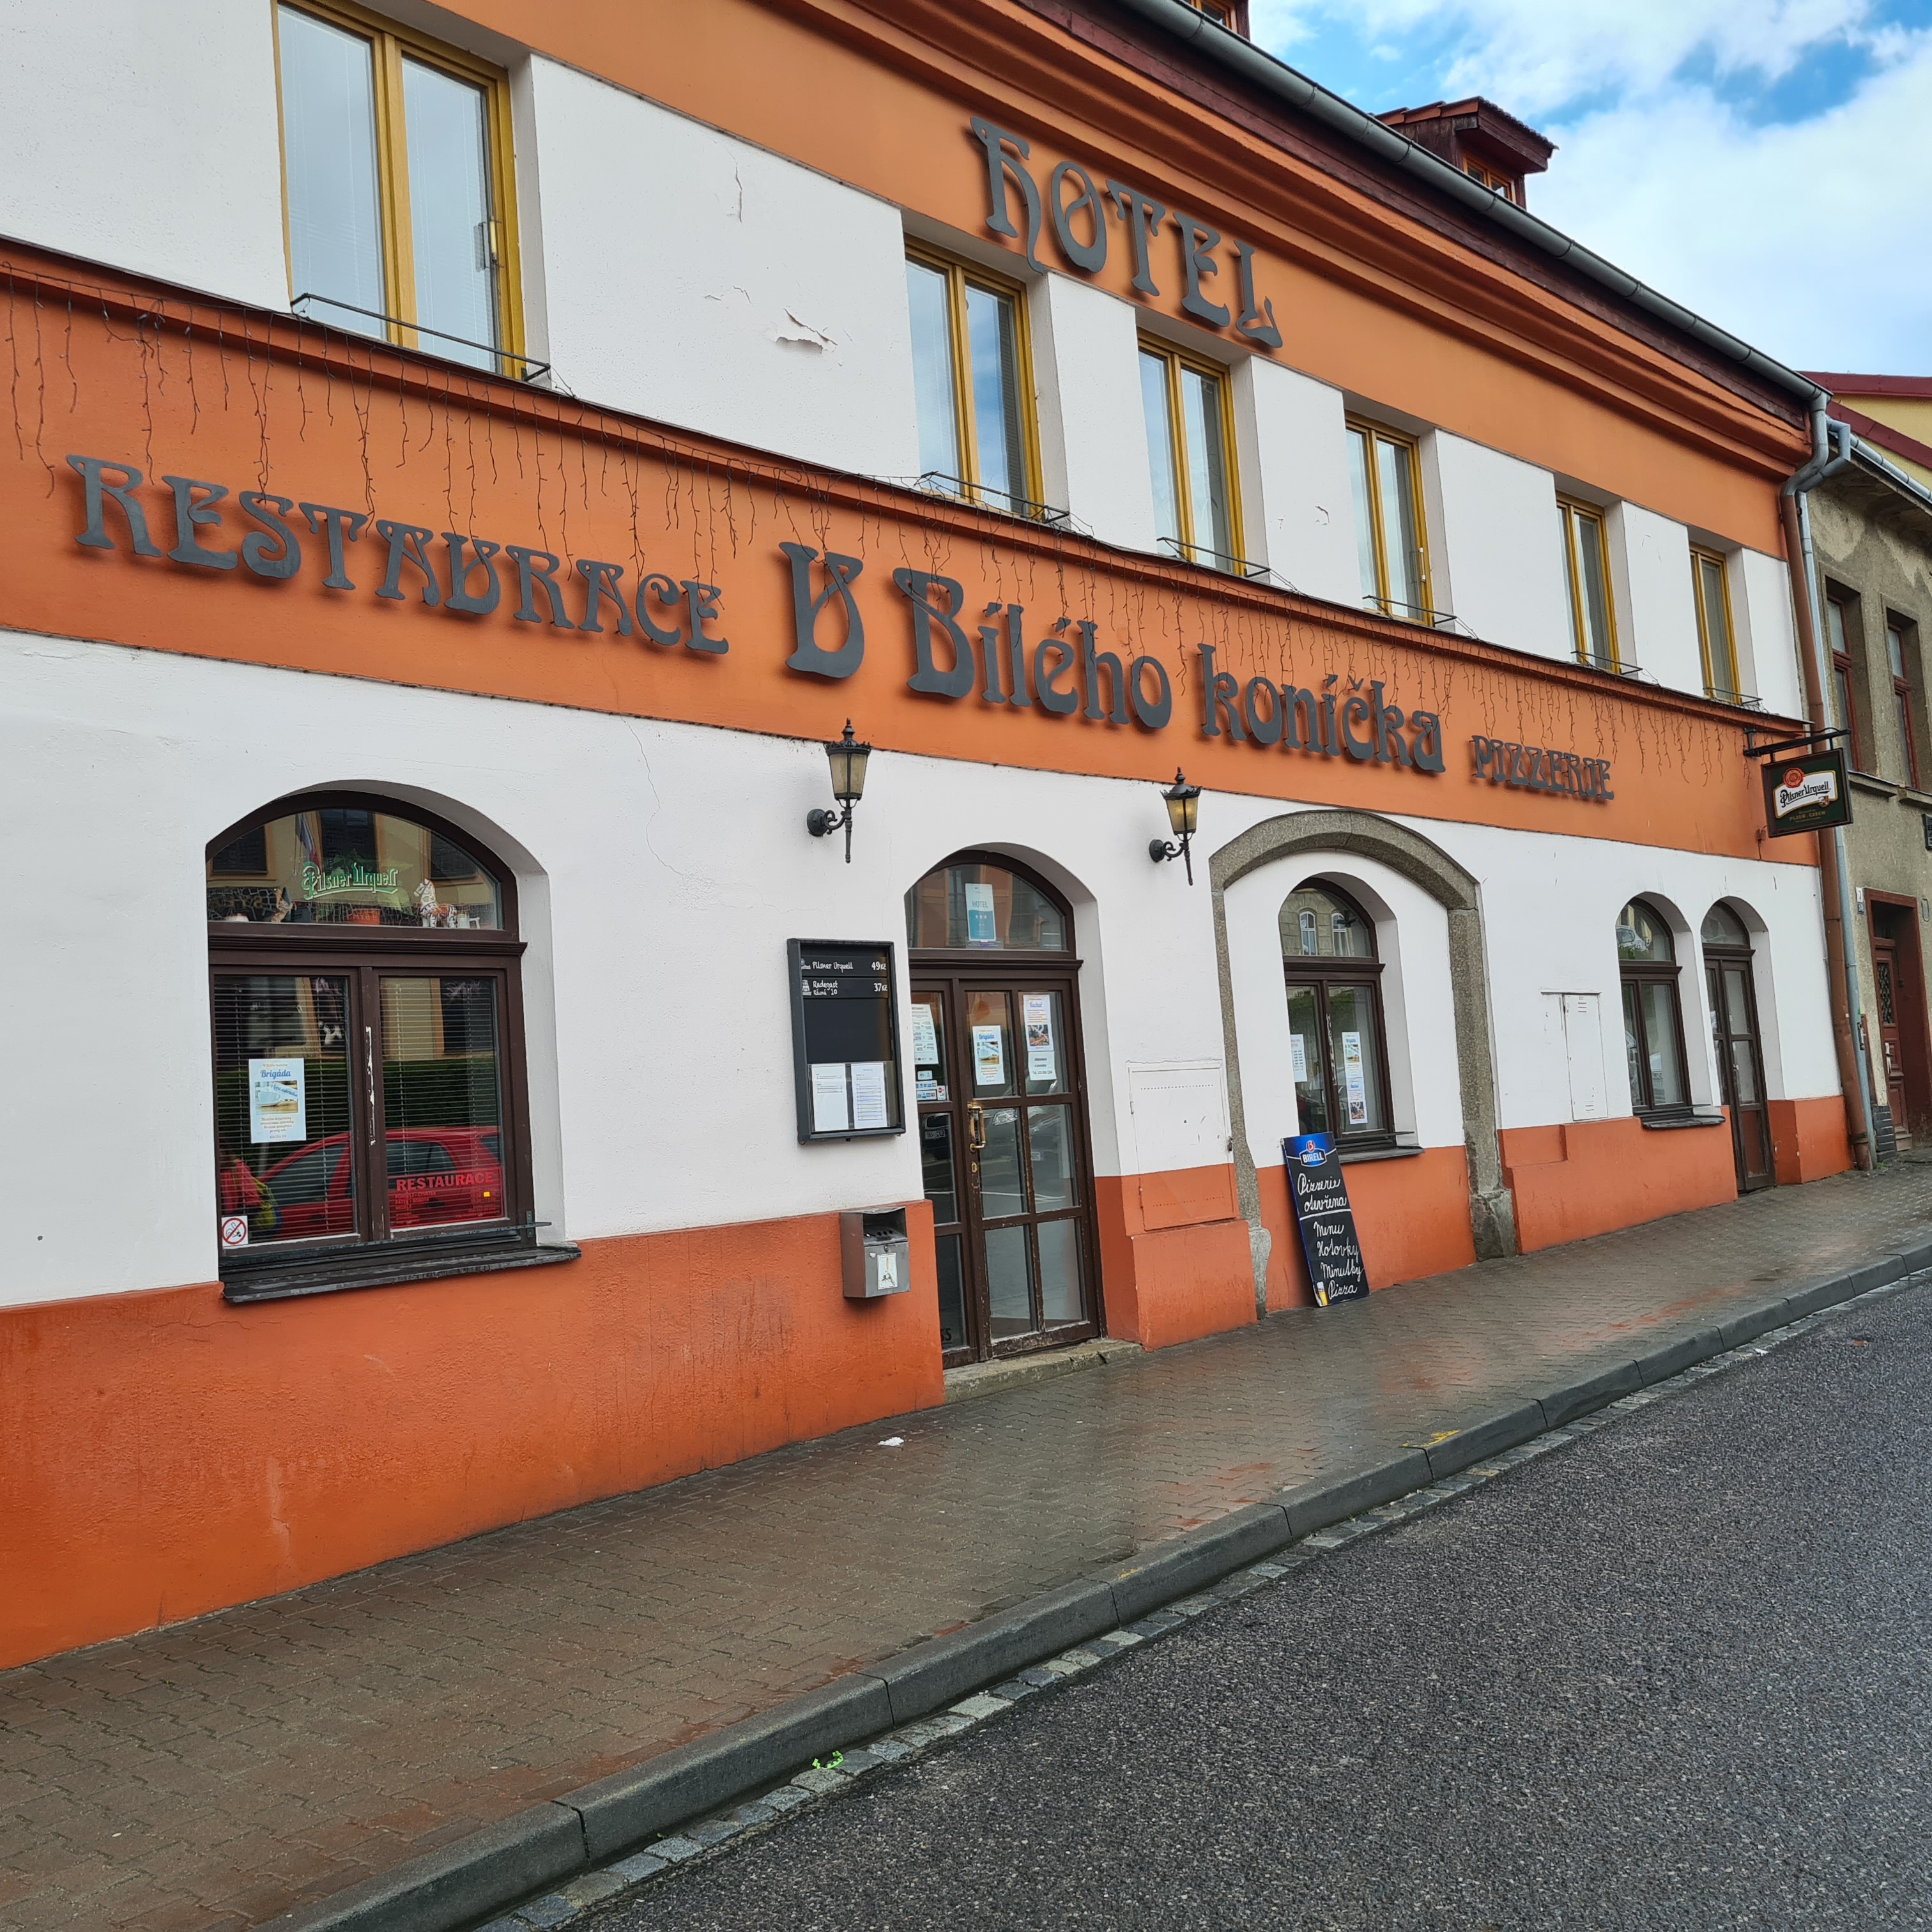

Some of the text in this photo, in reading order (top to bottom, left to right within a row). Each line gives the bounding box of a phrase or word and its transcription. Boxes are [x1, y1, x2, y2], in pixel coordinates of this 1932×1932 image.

[970, 116, 1283, 349] HOTEL
[66, 454, 729, 654] RESTAURACE
[892, 567, 1172, 728] Bílého
[1197, 643, 1446, 772] koníčka
[1780, 781, 1829, 808] Pilsner Urquell
[302, 861, 398, 900] Pilsner Urquell
[812, 961, 832, 970] Pilsner
[833, 962, 854, 973] Urquell
[813, 979, 838, 991] Radegast
[260, 1069, 291, 1079] Brigáda
[1302, 1152, 1324, 1163] BIRELL
[396, 1172, 494, 1192] RESTAURACE
[1298, 1173, 1340, 1195] Pizzerie
[1304, 1194, 1347, 1212] otevřena
[1314, 1222, 1344, 1237] Menu
[1317, 1236, 1359, 1263] Hotovky
[1321, 1259, 1365, 1282] Minutky
[1328, 1280, 1358, 1300] Pizza
